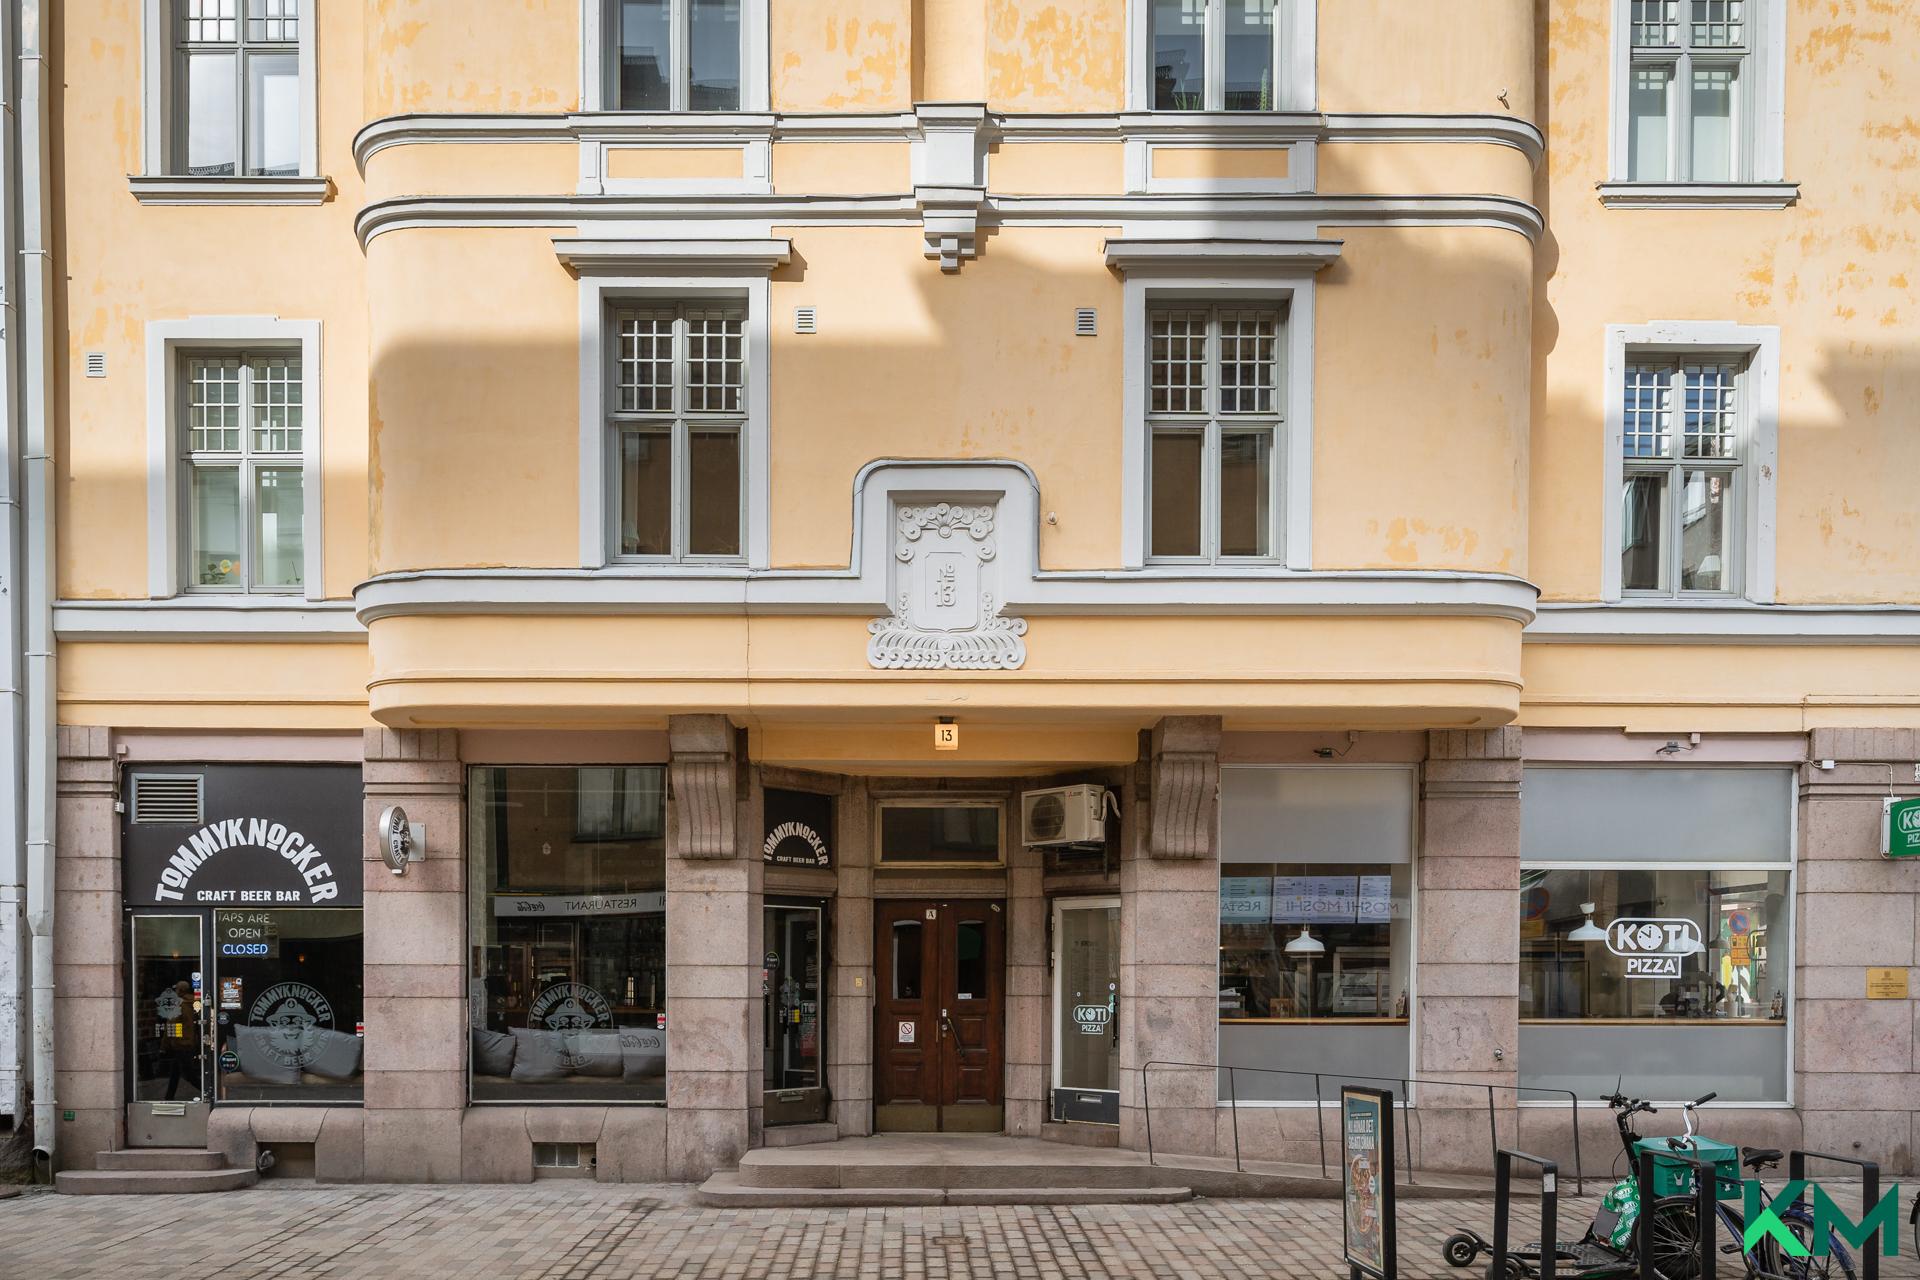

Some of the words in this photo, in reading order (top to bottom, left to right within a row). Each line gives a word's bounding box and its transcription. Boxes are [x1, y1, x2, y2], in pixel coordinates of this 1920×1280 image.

[940, 729, 953, 742] 13
[154, 817, 339, 904] TOMMYKNOCKER
[196, 890, 236, 901] CRAFT
[240, 890, 272, 901] BEER
[276, 890, 300, 901] BAR
[217, 912, 244, 923] TAPS
[247, 913, 271, 923] ARE
[928, 909, 935, 918] A
[228, 927, 261, 939] OPEN
[1617, 923, 1690, 951] KOTI
[222, 943, 268, 955] CLOSED
[1627, 958, 1676, 973] PIZZA
[250, 984, 331, 1022] TOMMYKNOCKER
[1077, 1007, 1106, 1021] KOTI
[1081, 1024, 1101, 1032] PIZZA
